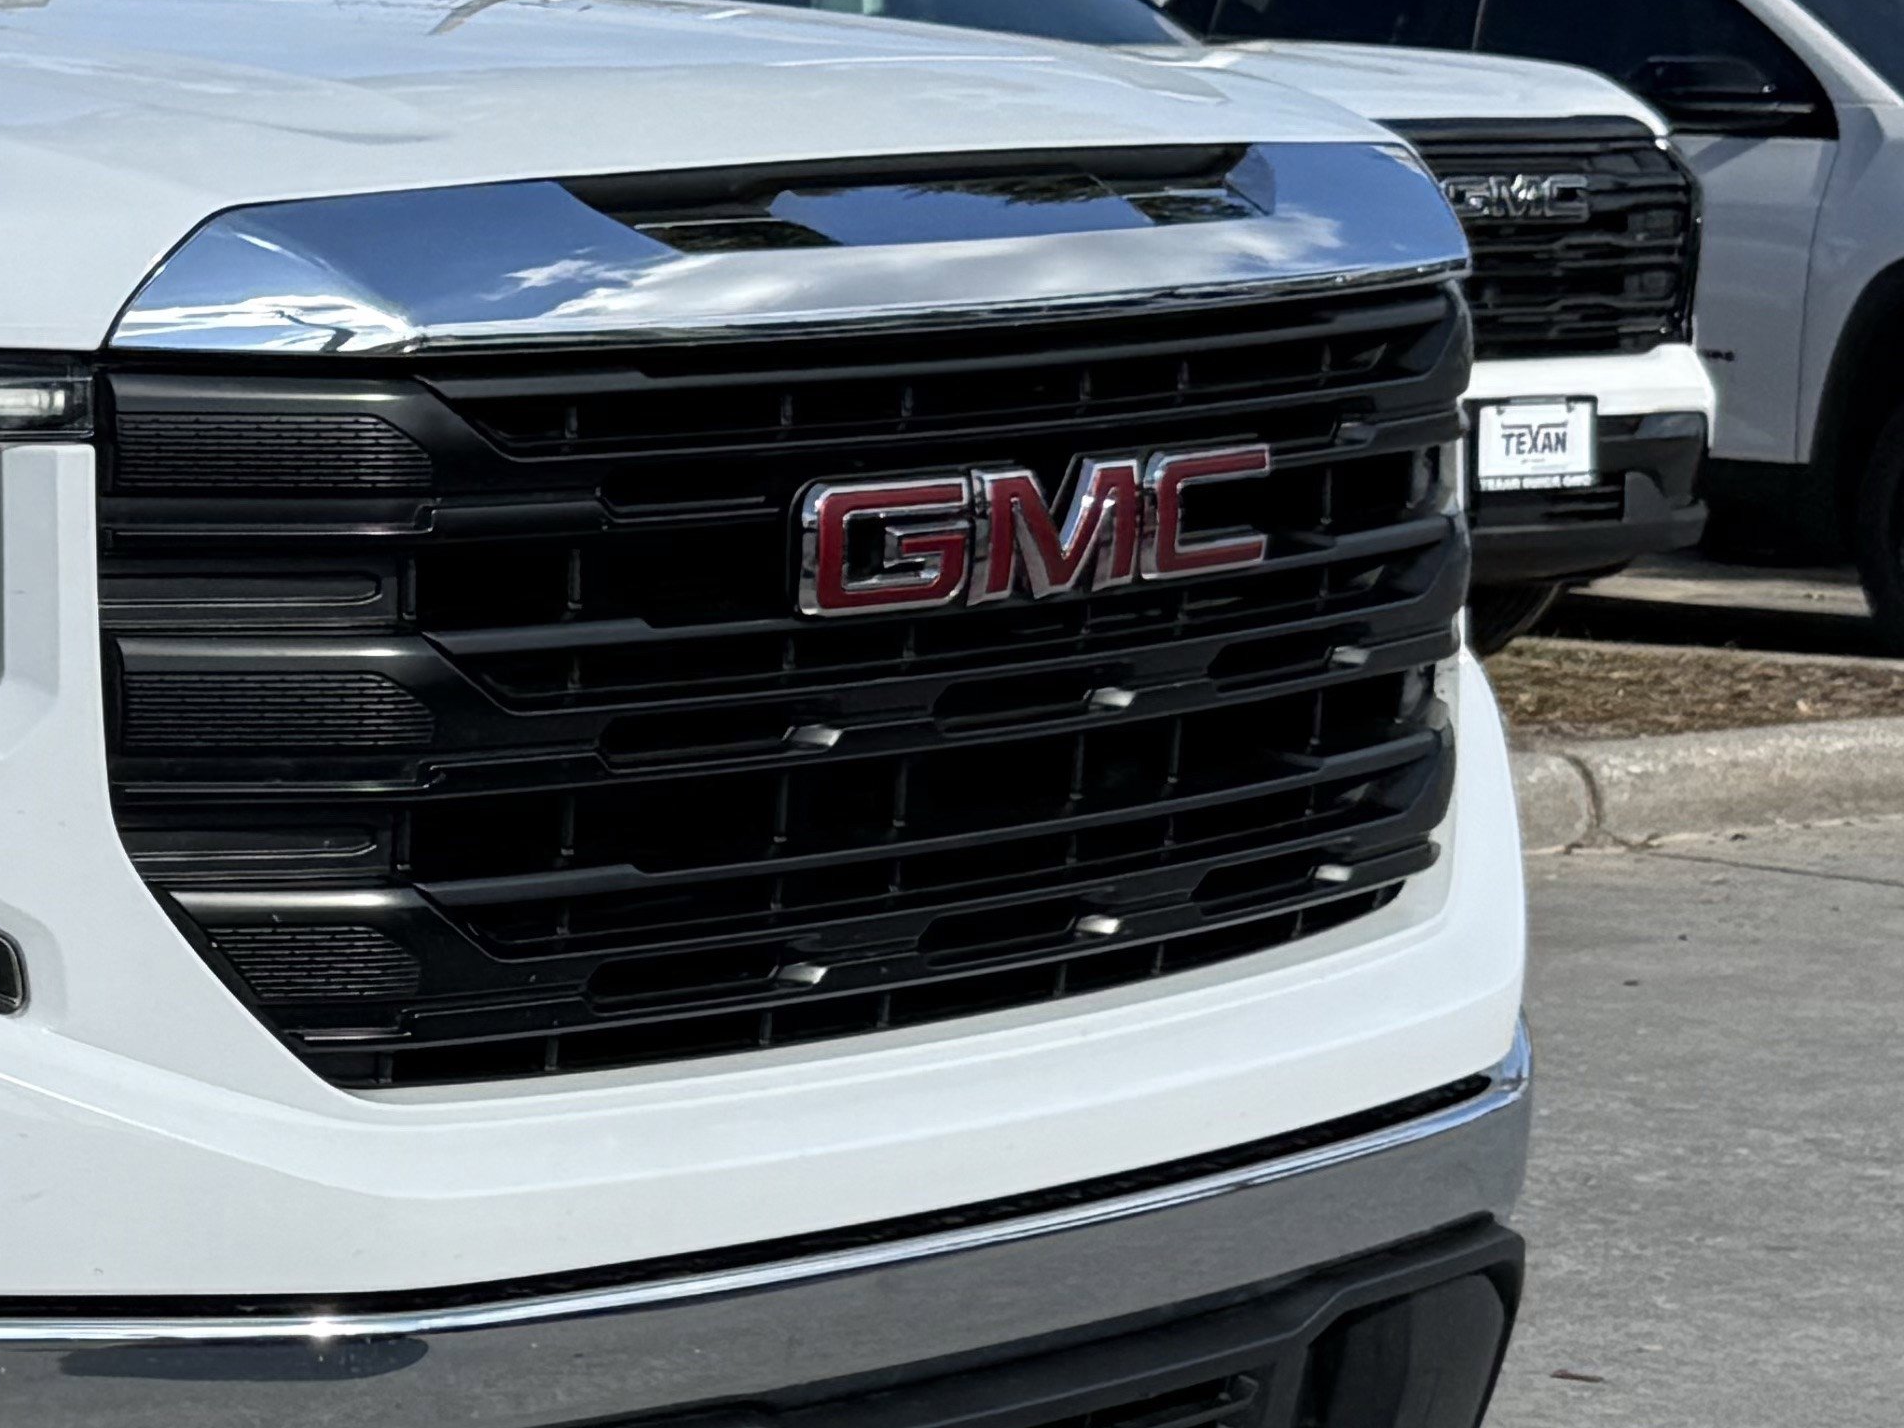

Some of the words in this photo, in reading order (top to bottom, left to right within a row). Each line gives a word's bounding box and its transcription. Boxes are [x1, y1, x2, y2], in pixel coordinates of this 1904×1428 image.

[1440, 174, 1590, 222] GMC
[1500, 423, 1568, 457] TEXAN
[796, 443, 1271, 618] GMC
